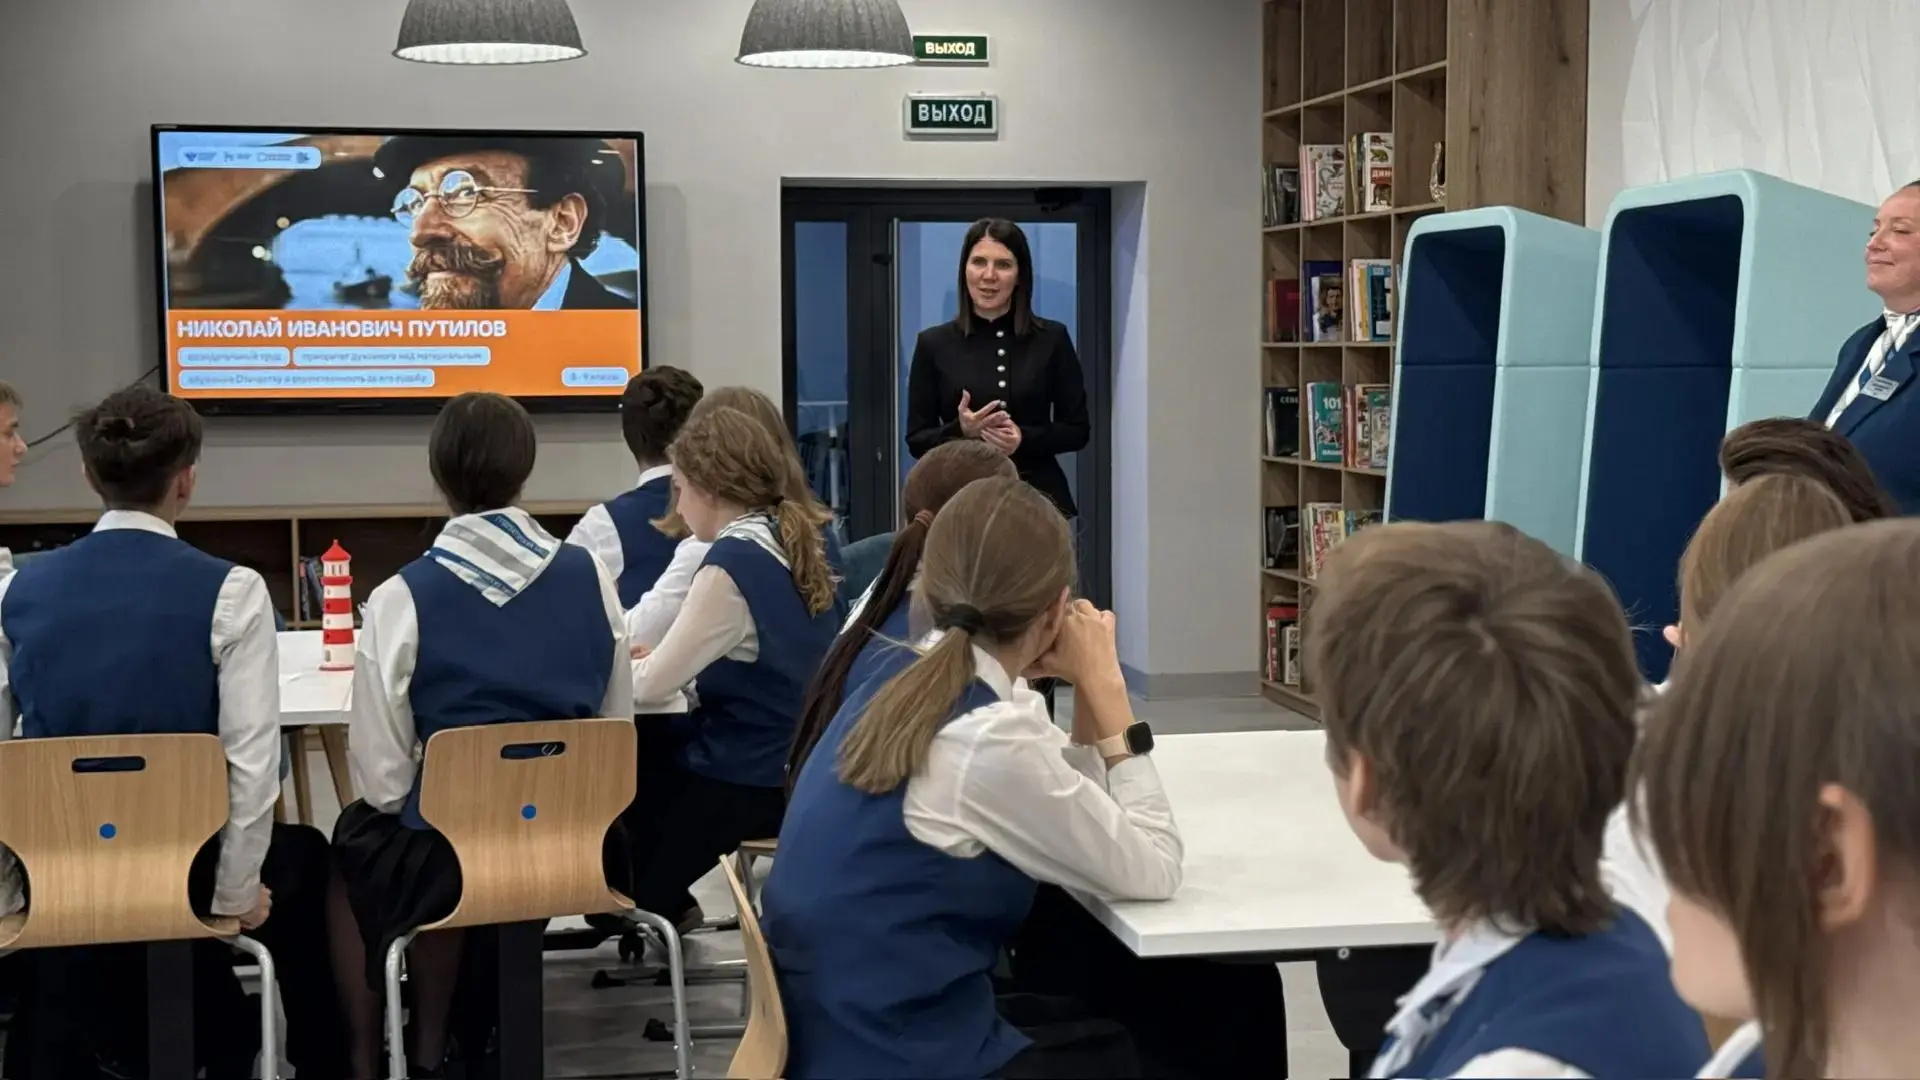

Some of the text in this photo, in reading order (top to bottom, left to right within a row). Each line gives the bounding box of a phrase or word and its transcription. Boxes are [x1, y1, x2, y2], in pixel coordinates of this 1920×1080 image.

[925, 42, 975, 56] ВЫХОД
[918, 103, 986, 125] ВЫХОД
[177, 316, 507, 338] НИКОЛАЙ ИВАНОВИЧ ПУТИЛОВ
